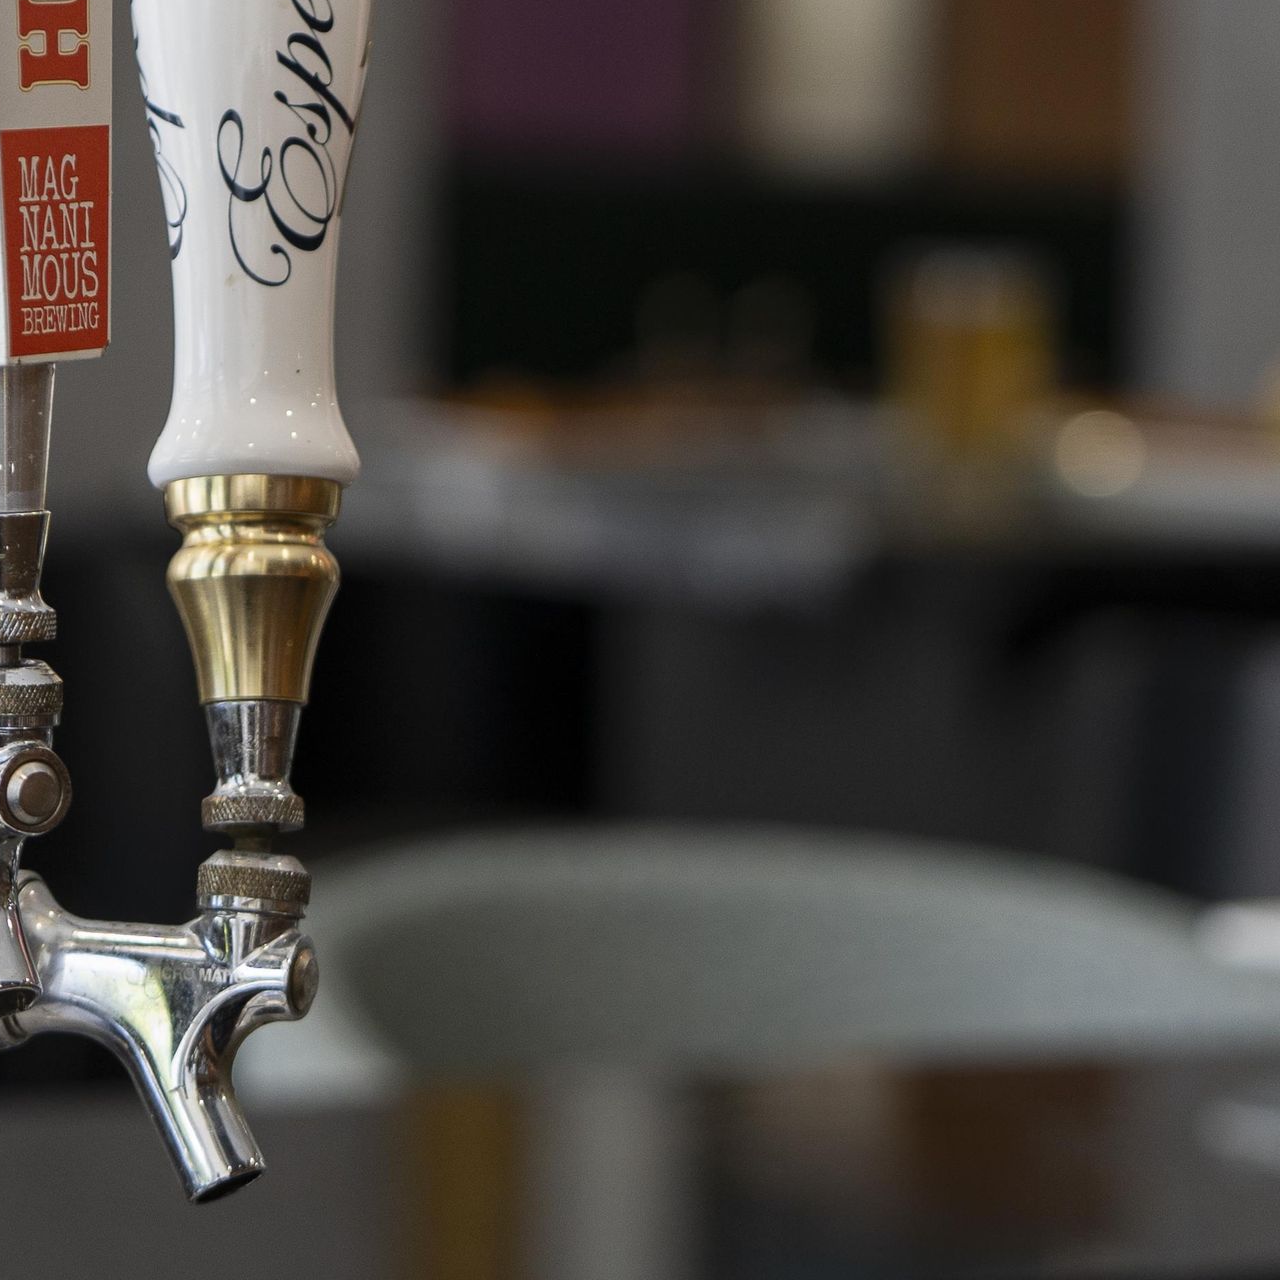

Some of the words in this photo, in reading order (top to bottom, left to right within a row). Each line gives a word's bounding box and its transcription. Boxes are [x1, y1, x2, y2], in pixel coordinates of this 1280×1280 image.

[18, 153, 79, 203] MAG
[19, 200, 95, 252] NANI
[20, 249, 99, 302] MOUS
[21, 301, 100, 336] BREWING
